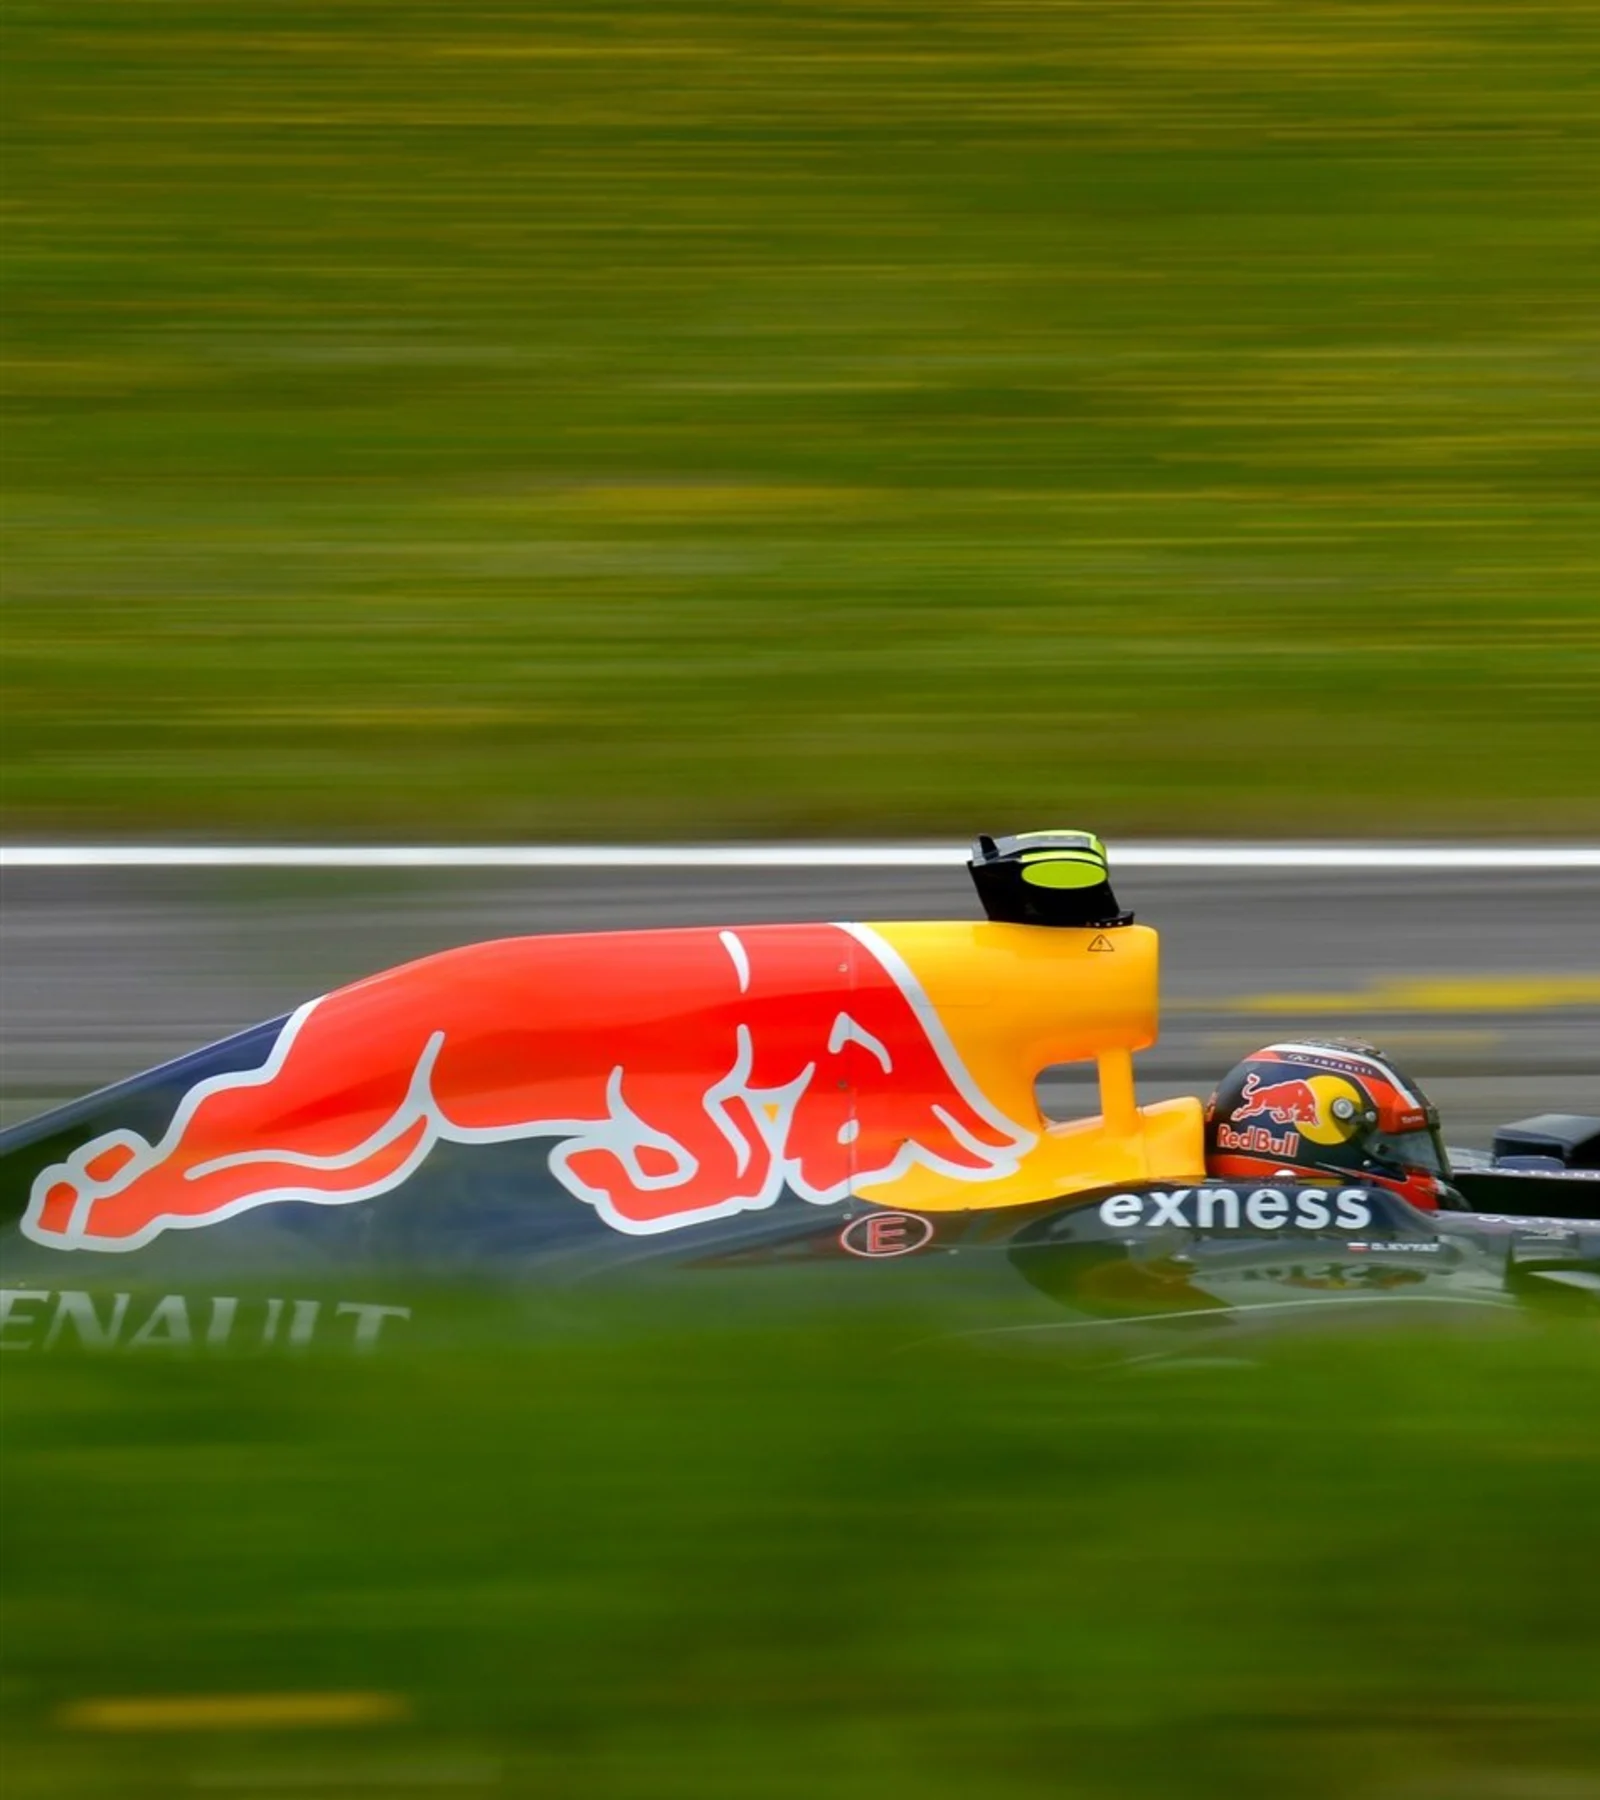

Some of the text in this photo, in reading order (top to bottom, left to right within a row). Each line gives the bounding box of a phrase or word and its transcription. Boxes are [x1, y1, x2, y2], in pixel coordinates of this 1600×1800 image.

[1313, 1057, 1374, 1075] INFINITI
[1217, 1123, 1299, 1157] Red Bull
[1099, 1188, 1372, 1230] exness
[867, 1217, 906, 1253] E
